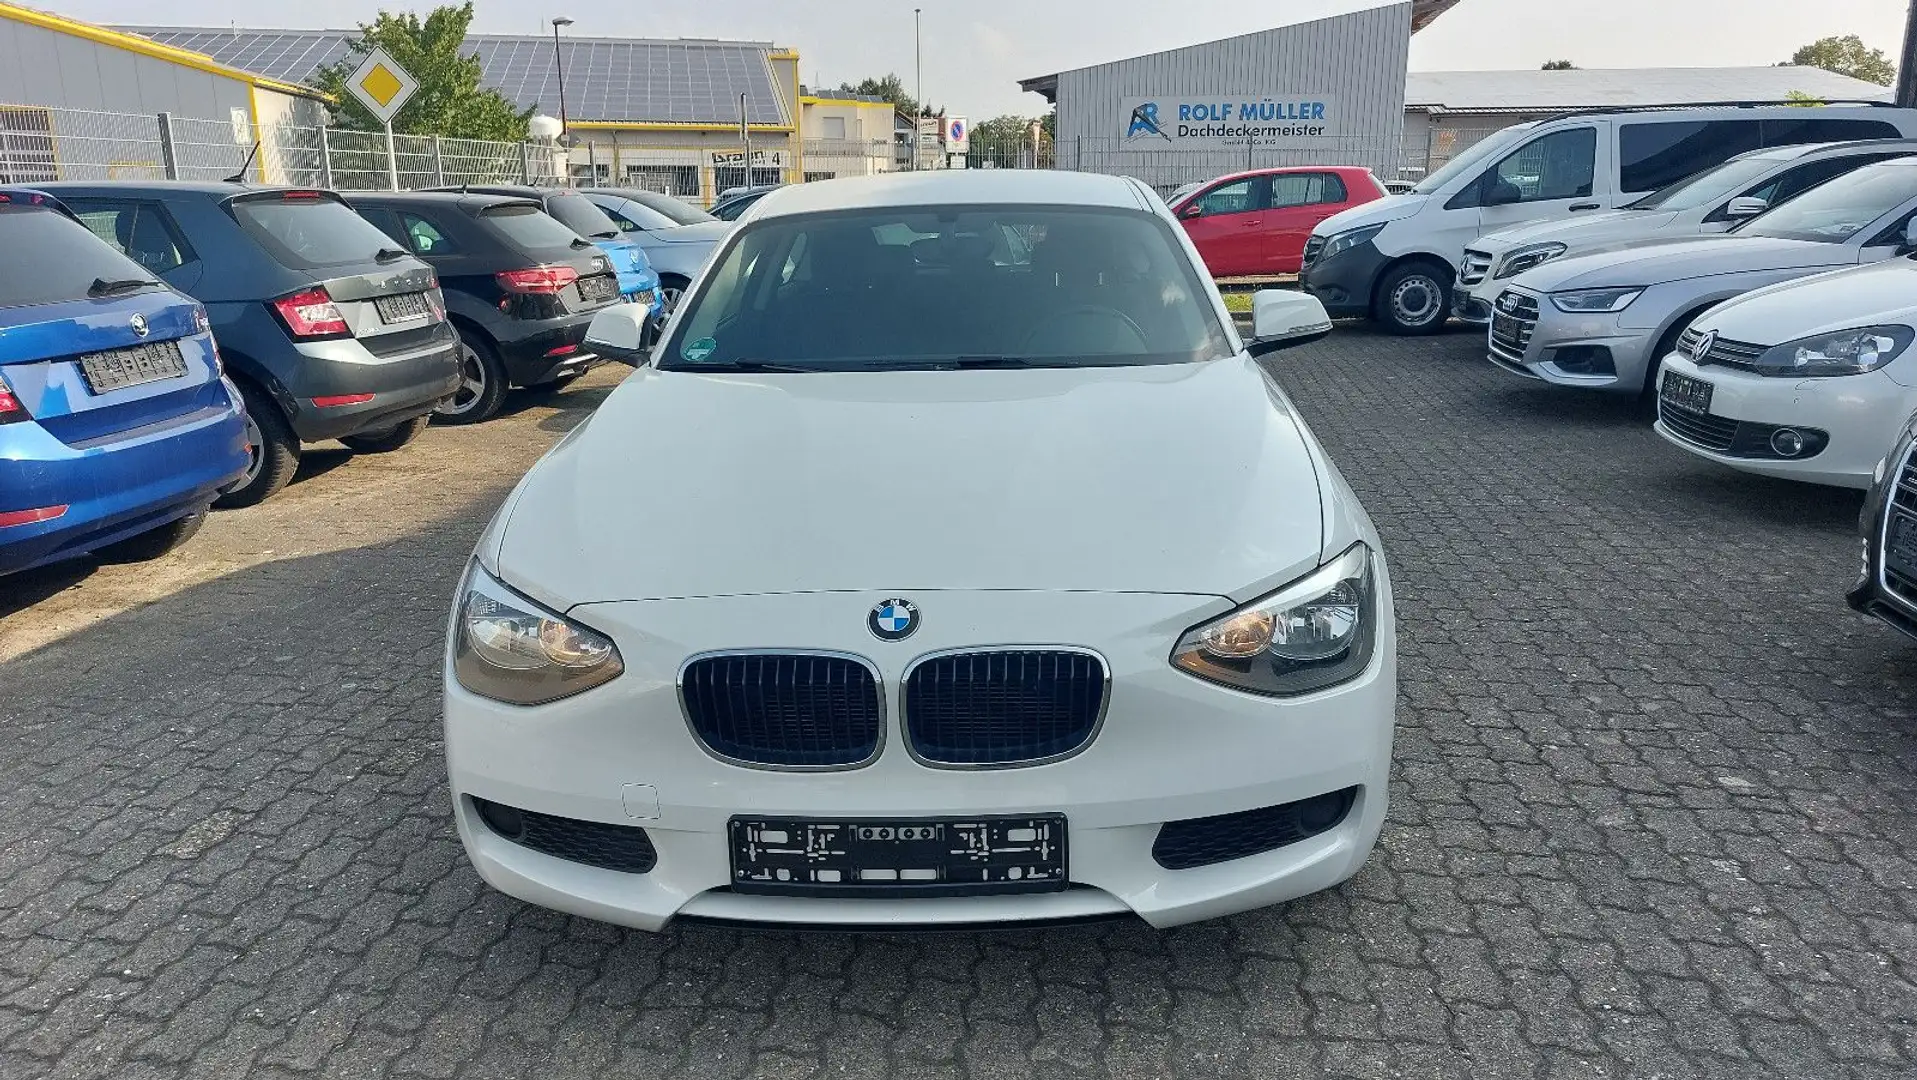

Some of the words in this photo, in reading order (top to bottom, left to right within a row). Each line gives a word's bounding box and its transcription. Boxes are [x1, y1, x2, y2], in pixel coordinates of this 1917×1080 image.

[1178, 103, 1233, 121] ROLF
[1238, 99, 1325, 121] MÜLLER
[1178, 123, 1325, 138] Dachdeckermeister
